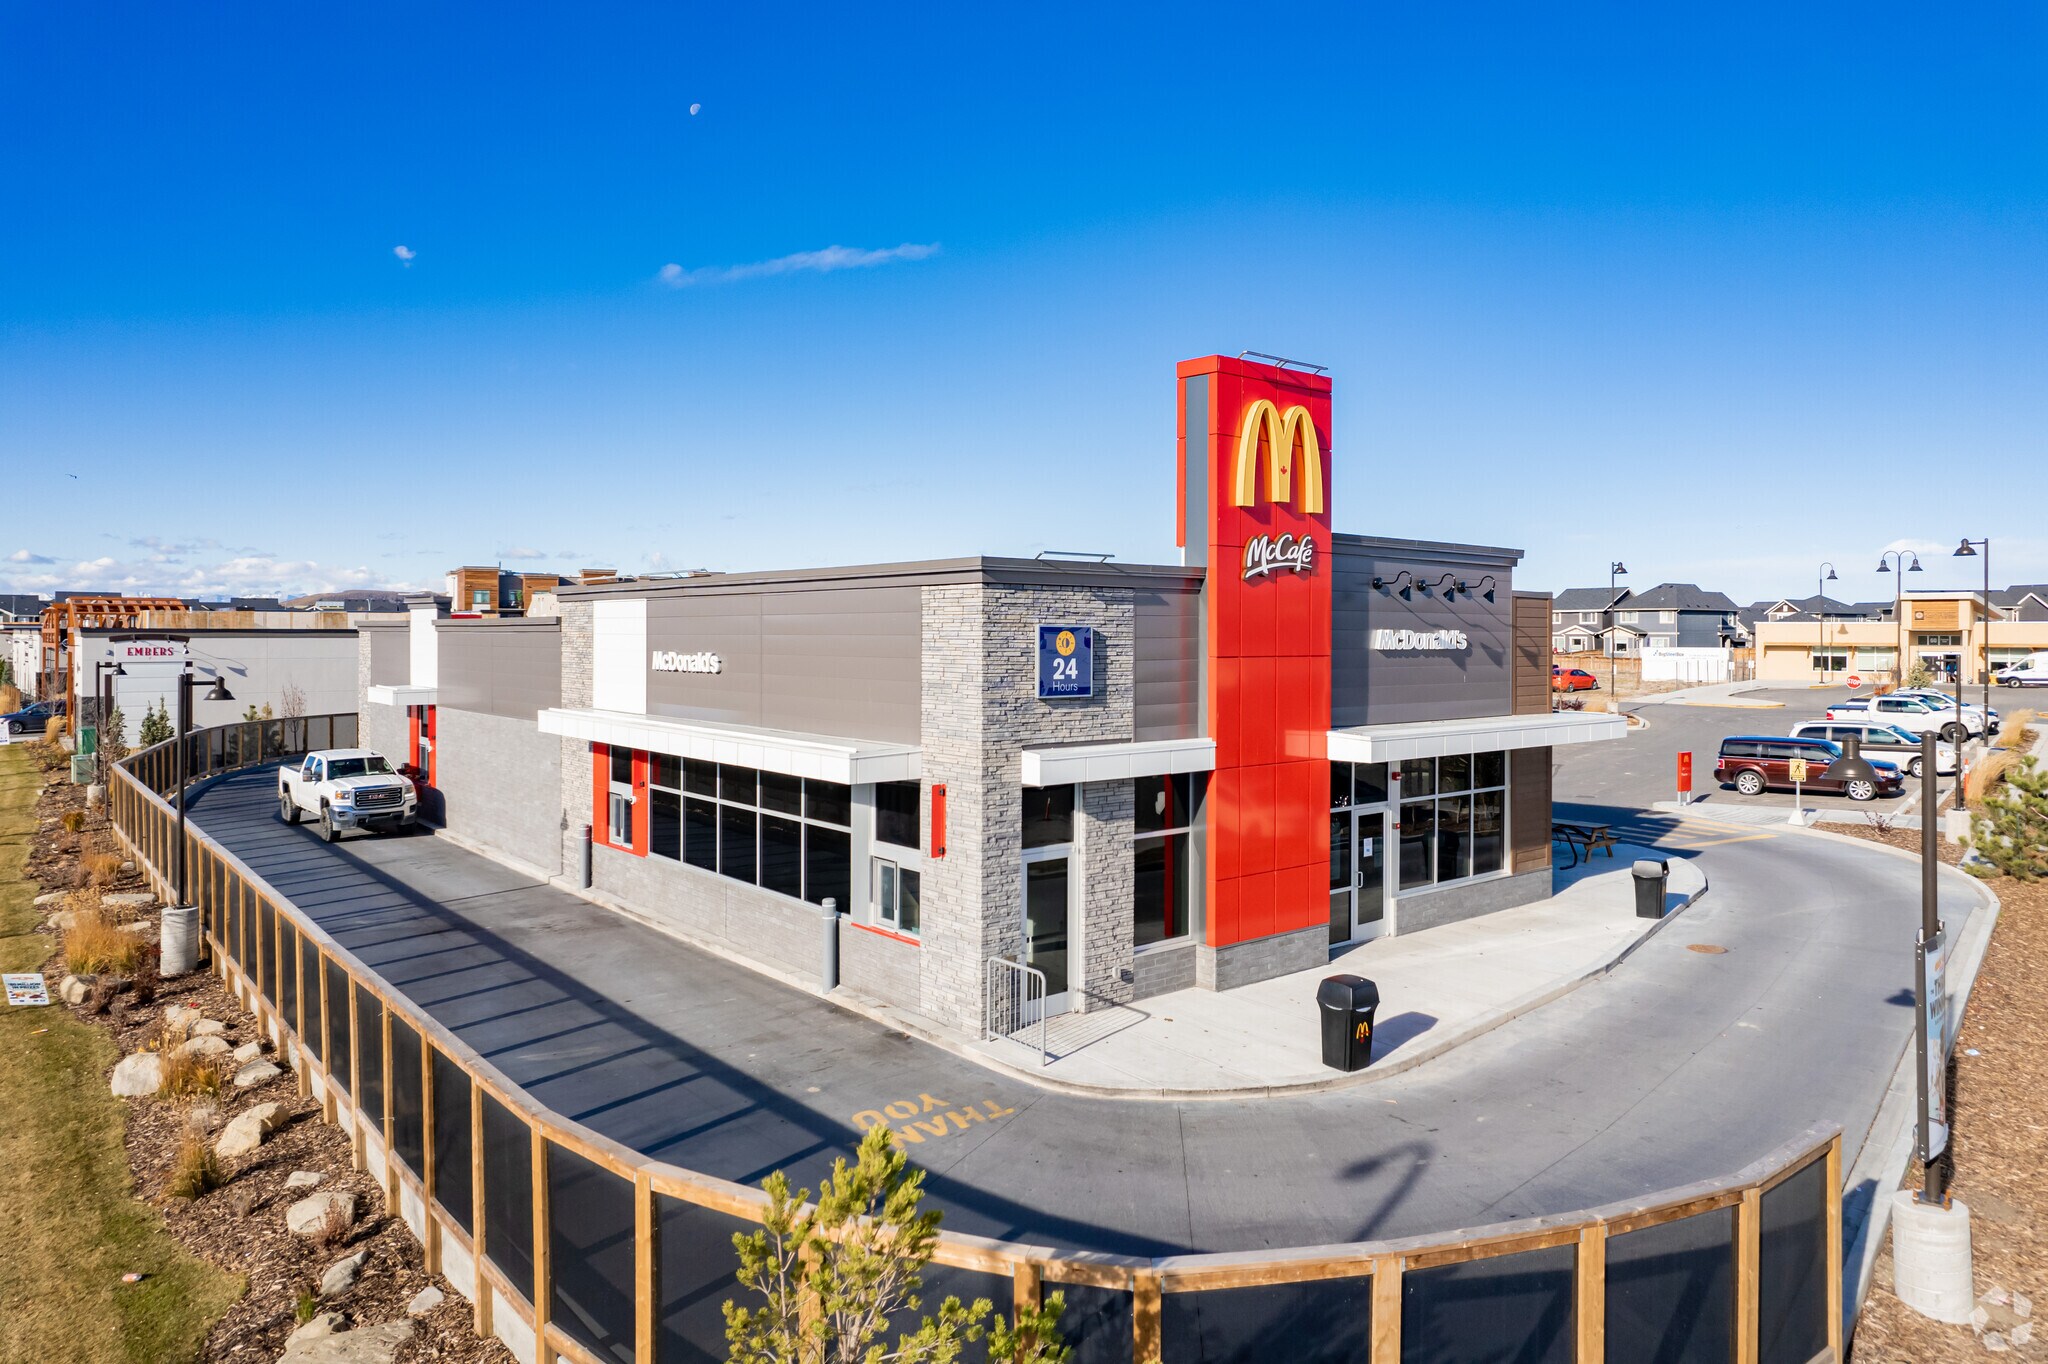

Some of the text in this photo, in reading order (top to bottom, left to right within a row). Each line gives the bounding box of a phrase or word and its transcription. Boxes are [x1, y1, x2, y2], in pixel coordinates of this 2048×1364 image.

[1246, 533, 1313, 578] McCafé
[1374, 629, 1468, 650] McDonald's
[127, 647, 174, 656] EMBERS
[652, 651, 721, 674] McDonald's
[1053, 658, 1078, 680] 24
[1052, 681, 1078, 692] Hours
[851, 1093, 951, 1131] YOU
[888, 1100, 1016, 1151] THAN
